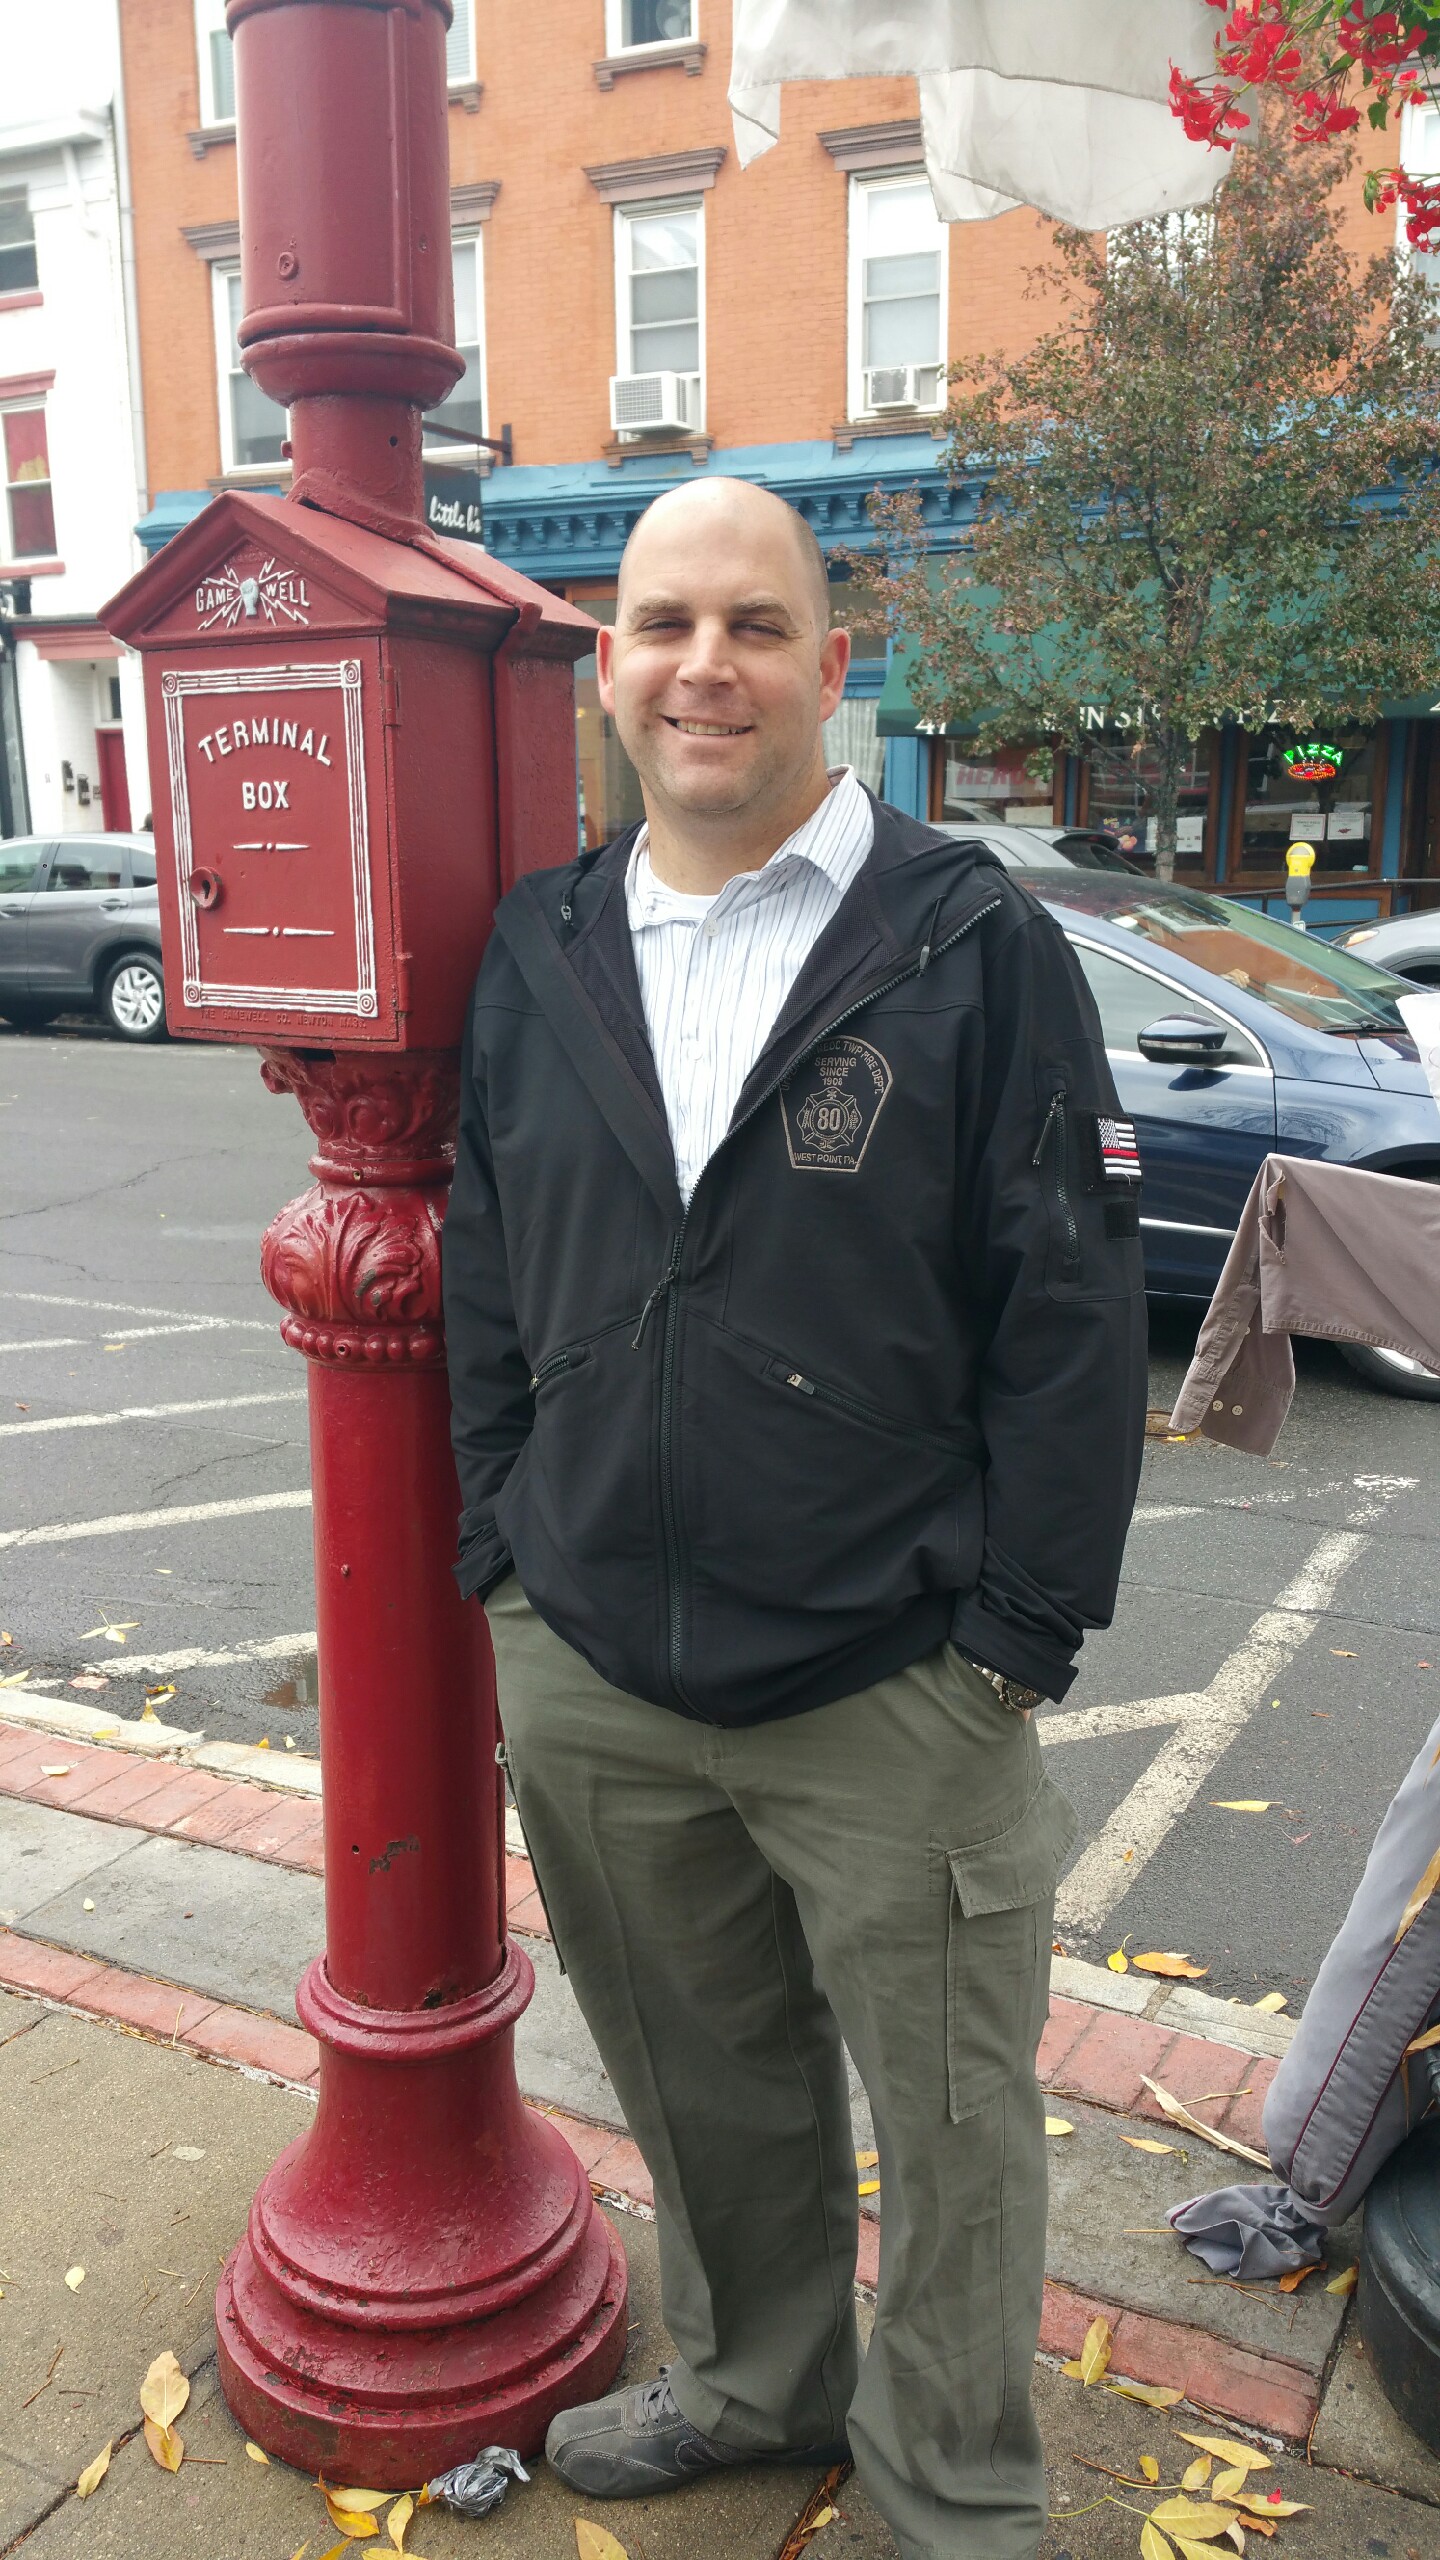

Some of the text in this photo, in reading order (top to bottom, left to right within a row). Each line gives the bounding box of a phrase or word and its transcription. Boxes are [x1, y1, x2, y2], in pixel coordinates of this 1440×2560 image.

[429, 495, 466, 529] little
[196, 580, 311, 612] GAME WELL
[197, 716, 332, 767] TERMINAL
[1283, 743, 1343, 767] PIZZA
[242, 780, 290, 810] BOX
[201, 1008, 216, 1020] THE
[223, 1009, 270, 1023] GAMEWELL
[297, 1014, 334, 1027] NEWTON
[814, 1056, 857, 1067] SERVING
[843, 1040, 863, 1054] TWP
[860, 1050, 879, 1070] FIRE
[819, 1067, 849, 1077] SINCE
[821, 1077, 843, 1086] 1908
[817, 1107, 841, 1131] 80
[793, 1152, 816, 1162] WEST
